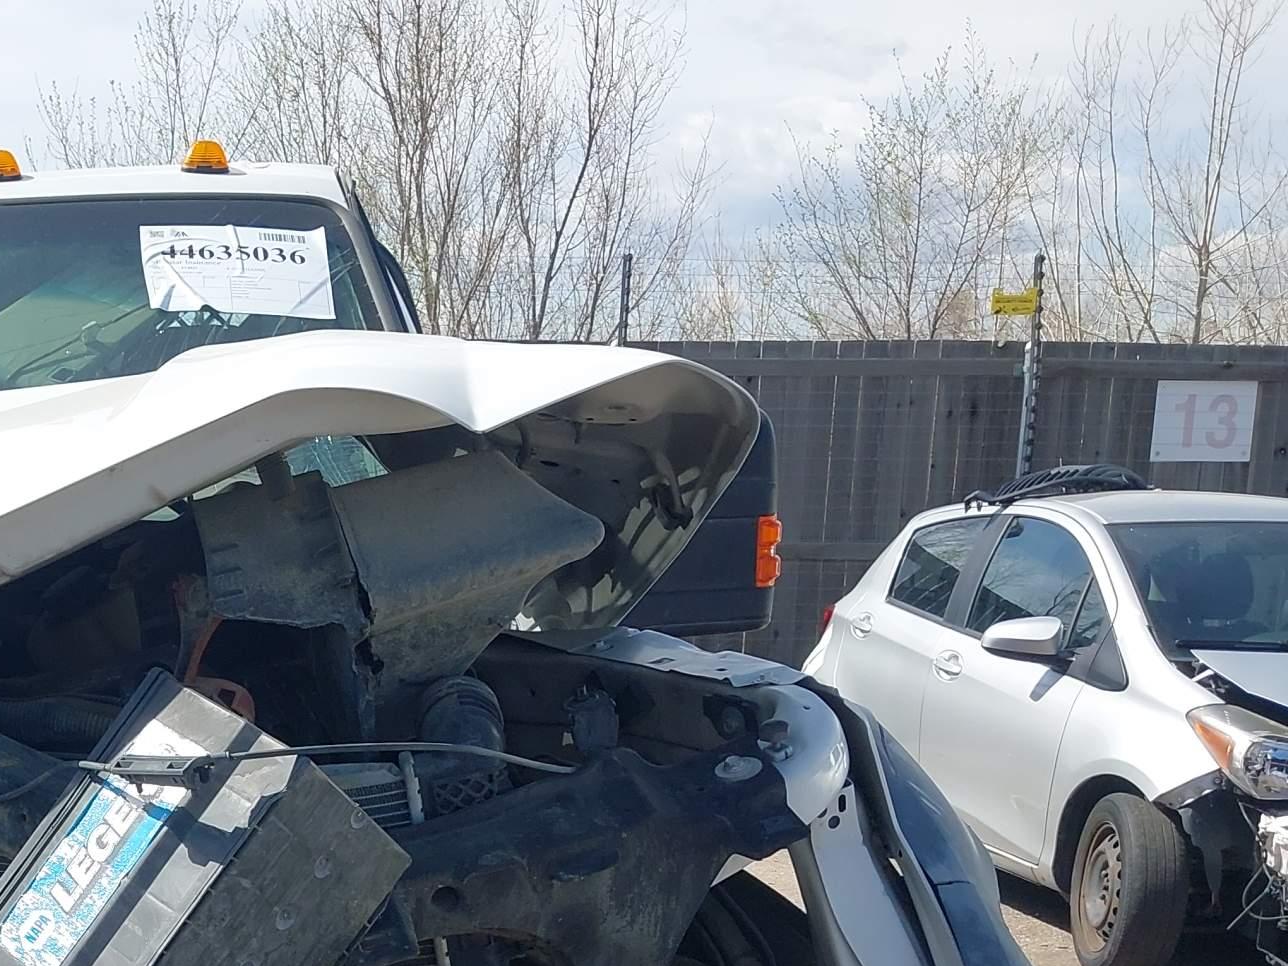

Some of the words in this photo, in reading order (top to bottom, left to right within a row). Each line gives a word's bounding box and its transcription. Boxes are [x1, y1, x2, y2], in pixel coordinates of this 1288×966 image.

[161, 244, 306, 265] 44635036
[1175, 393, 1238, 449] 13
[49, 795, 142, 915] LEGE
[24, 913, 52, 945] NAPA
